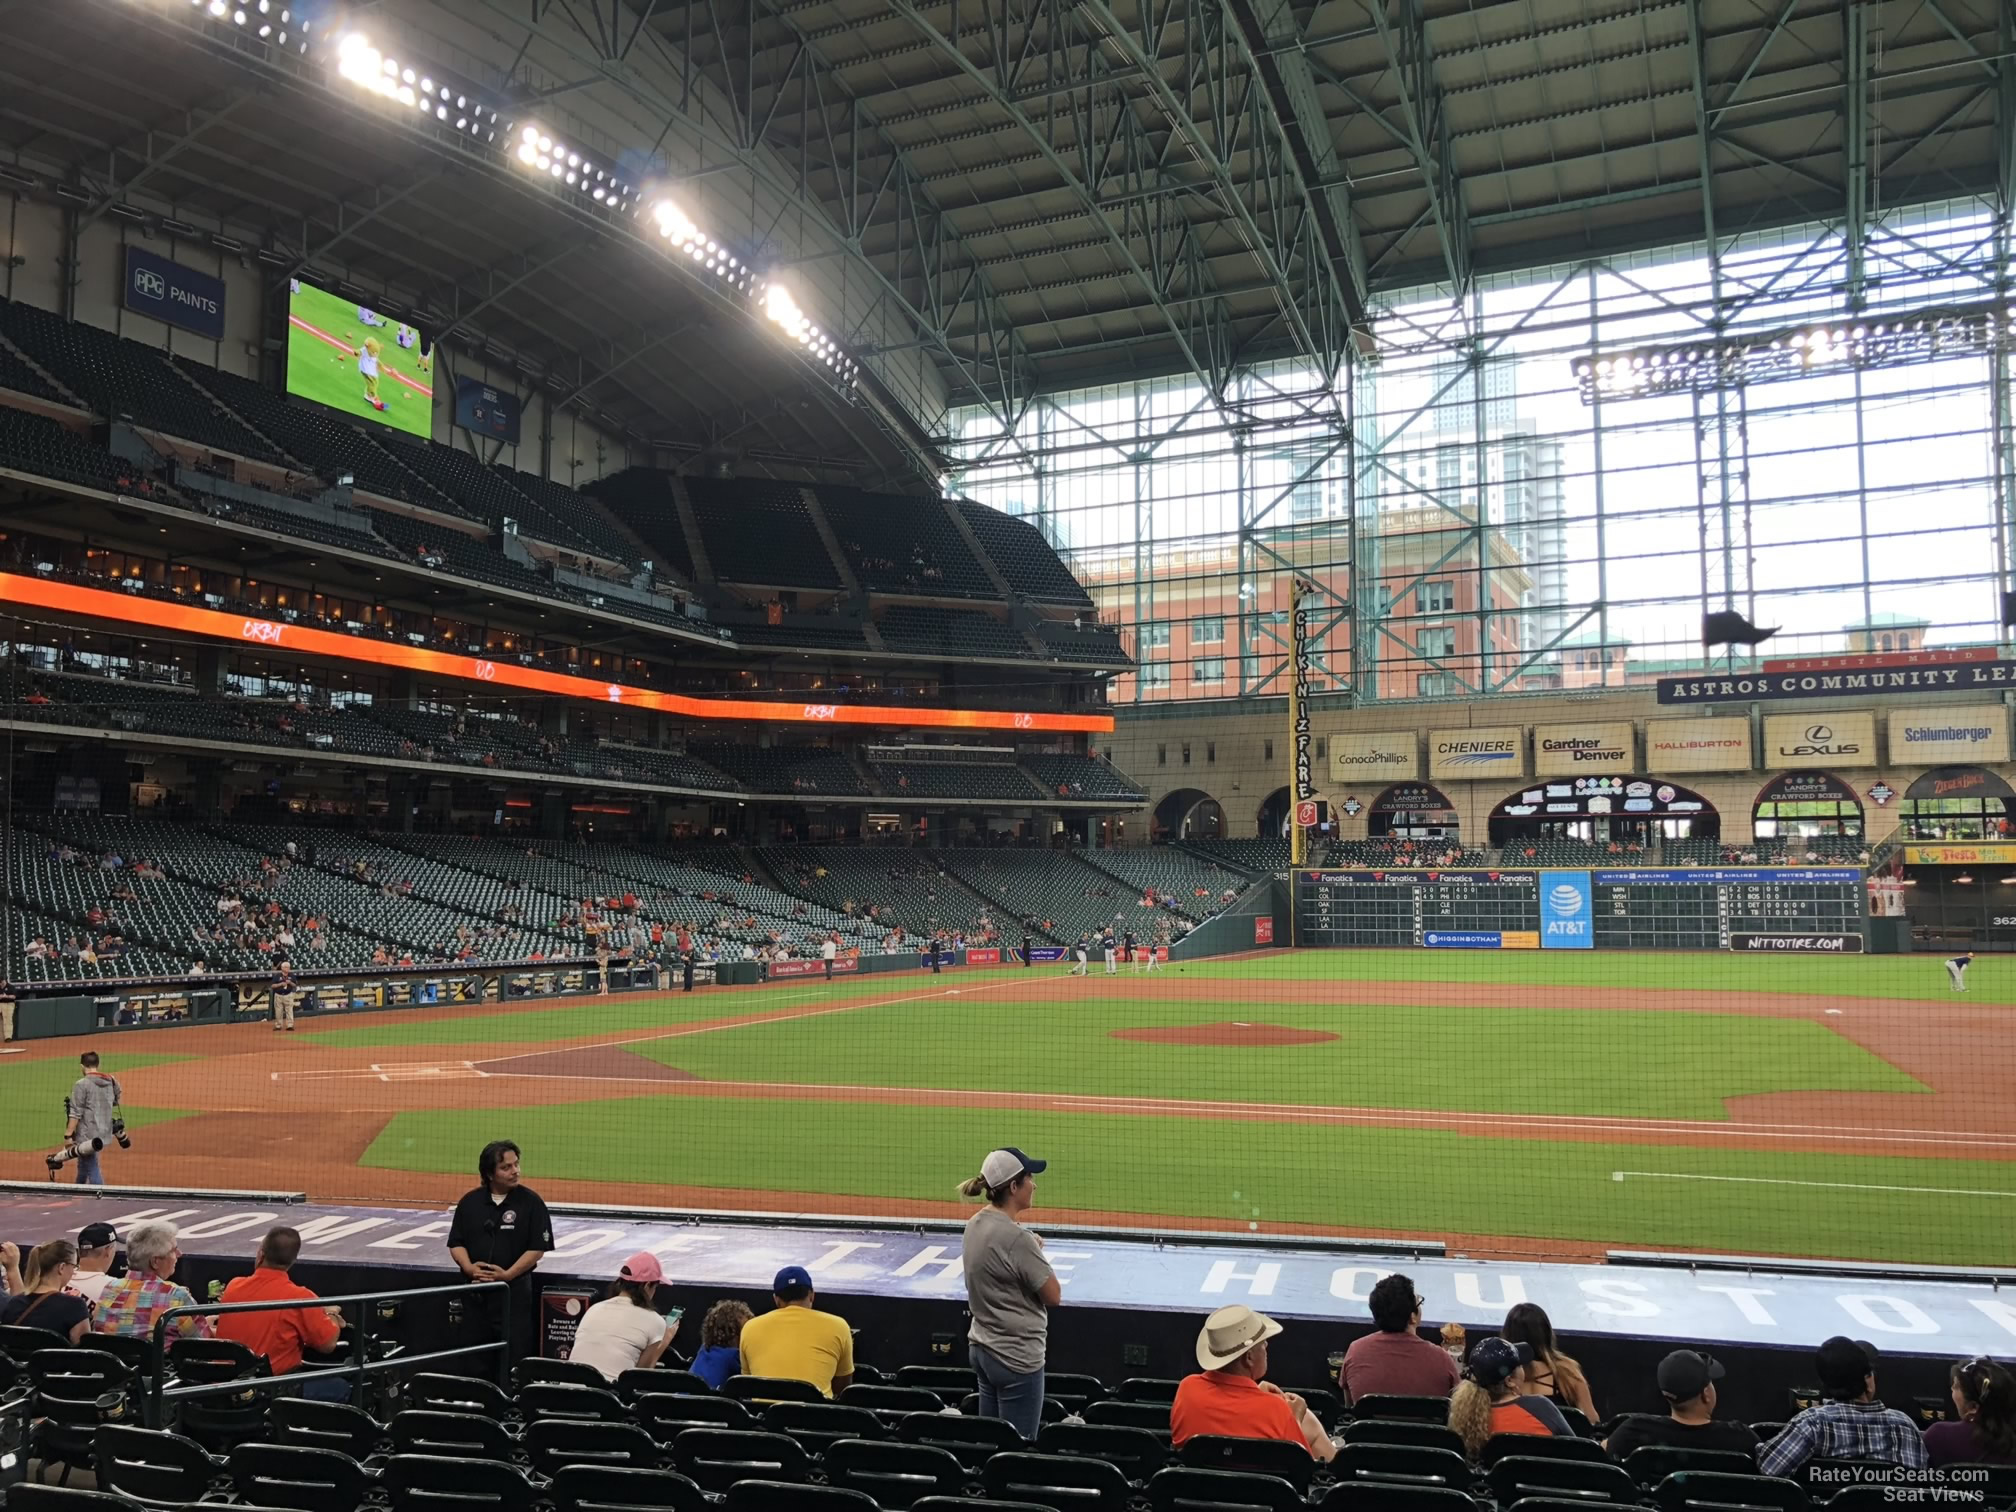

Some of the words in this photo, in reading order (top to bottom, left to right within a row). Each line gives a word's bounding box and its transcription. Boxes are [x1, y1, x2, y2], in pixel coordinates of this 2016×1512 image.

[137, 273, 162, 294] PPG
[170, 286, 217, 314] PAINTS
[1786, 656, 1883, 669] MINUTE
[1908, 651, 1973, 662] MAID
[1781, 669, 1958, 692] COMMUNITY
[1905, 726, 1992, 743] Schlumberger
[1438, 741, 1515, 753] CHENIERE
[1542, 738, 1601, 750] Gardner
[1655, 740, 1742, 750] HALLIBURTON
[1780, 744, 1860, 756] LEXUS
[1339, 753, 1408, 765] ConocoPhillips
[1573, 750, 1625, 761] Denver
[1784, 784, 1827, 792] LANDRY'S
[1942, 849, 1977, 861] Fiesta
[1273, 872, 1289, 880] 315
[1321, 874, 1353, 882] Fanatics
[1385, 874, 1417, 882] Fanatics
[1439, 874, 1473, 882] Fanatics
[1499, 873, 1533, 882] Fanatics
[1720, 888, 1728, 945] AMERICAN
[1993, 917, 2016, 926] 362
[1547, 920, 1587, 935] AT&T
[1748, 936, 1844, 950] NITTOTIRE.COM
